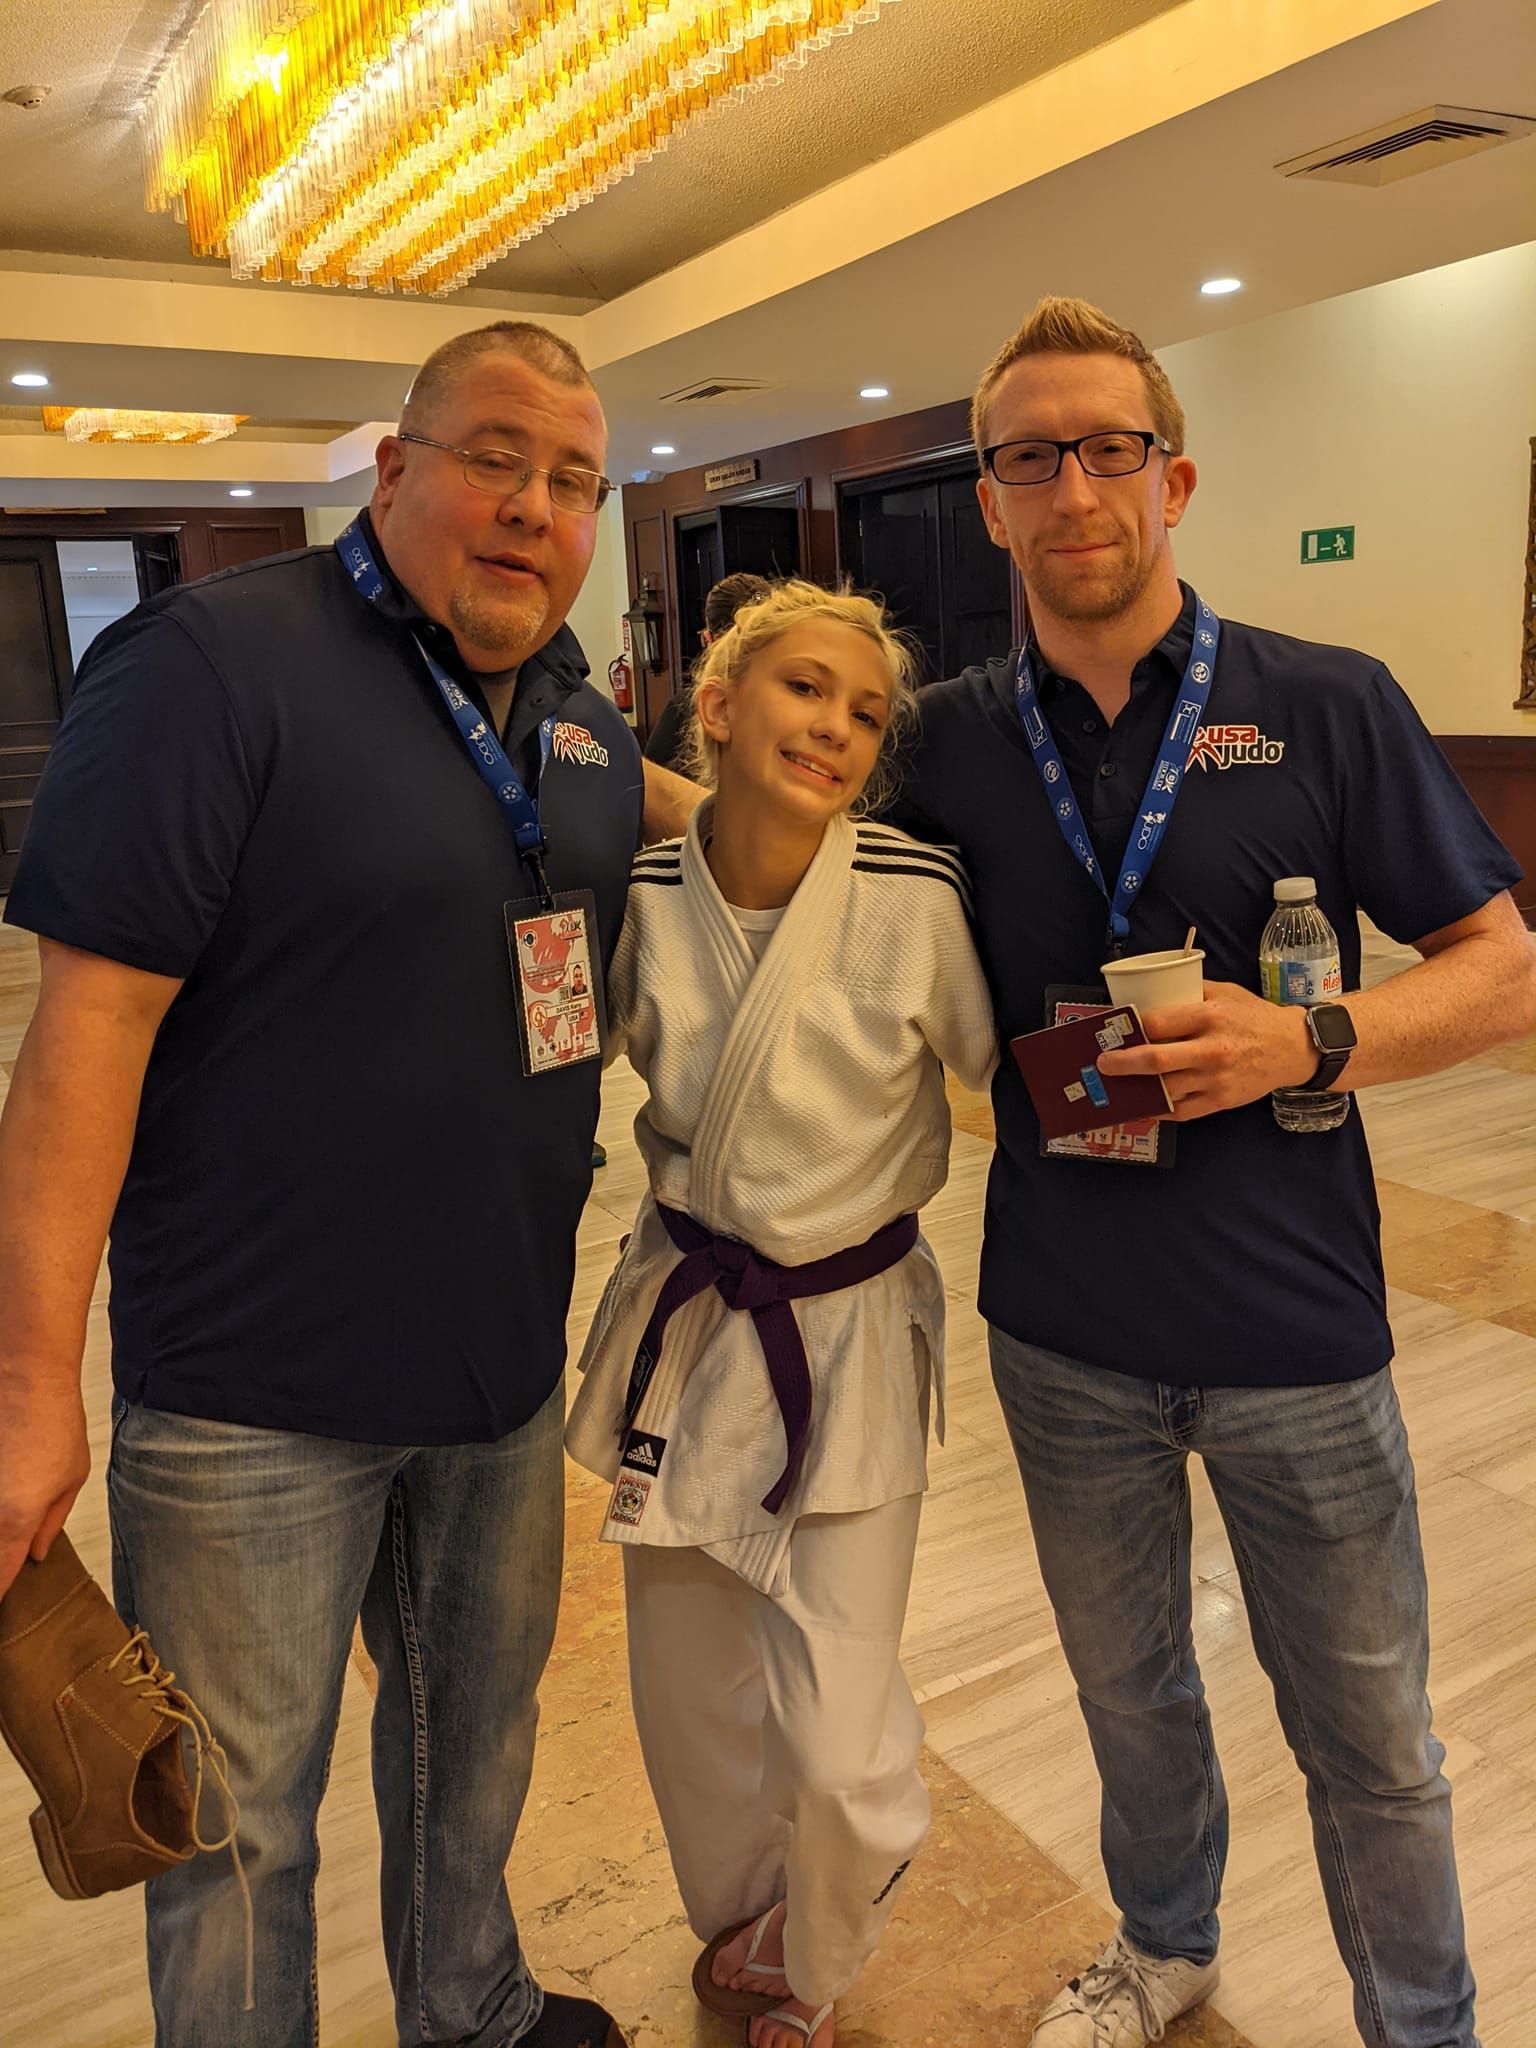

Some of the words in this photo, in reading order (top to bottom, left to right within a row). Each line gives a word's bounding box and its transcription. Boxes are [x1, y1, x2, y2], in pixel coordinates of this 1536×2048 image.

[1208, 726, 1257, 744] usa
[1219, 735, 1282, 769] judo
[626, 1451, 657, 1468] adidas
